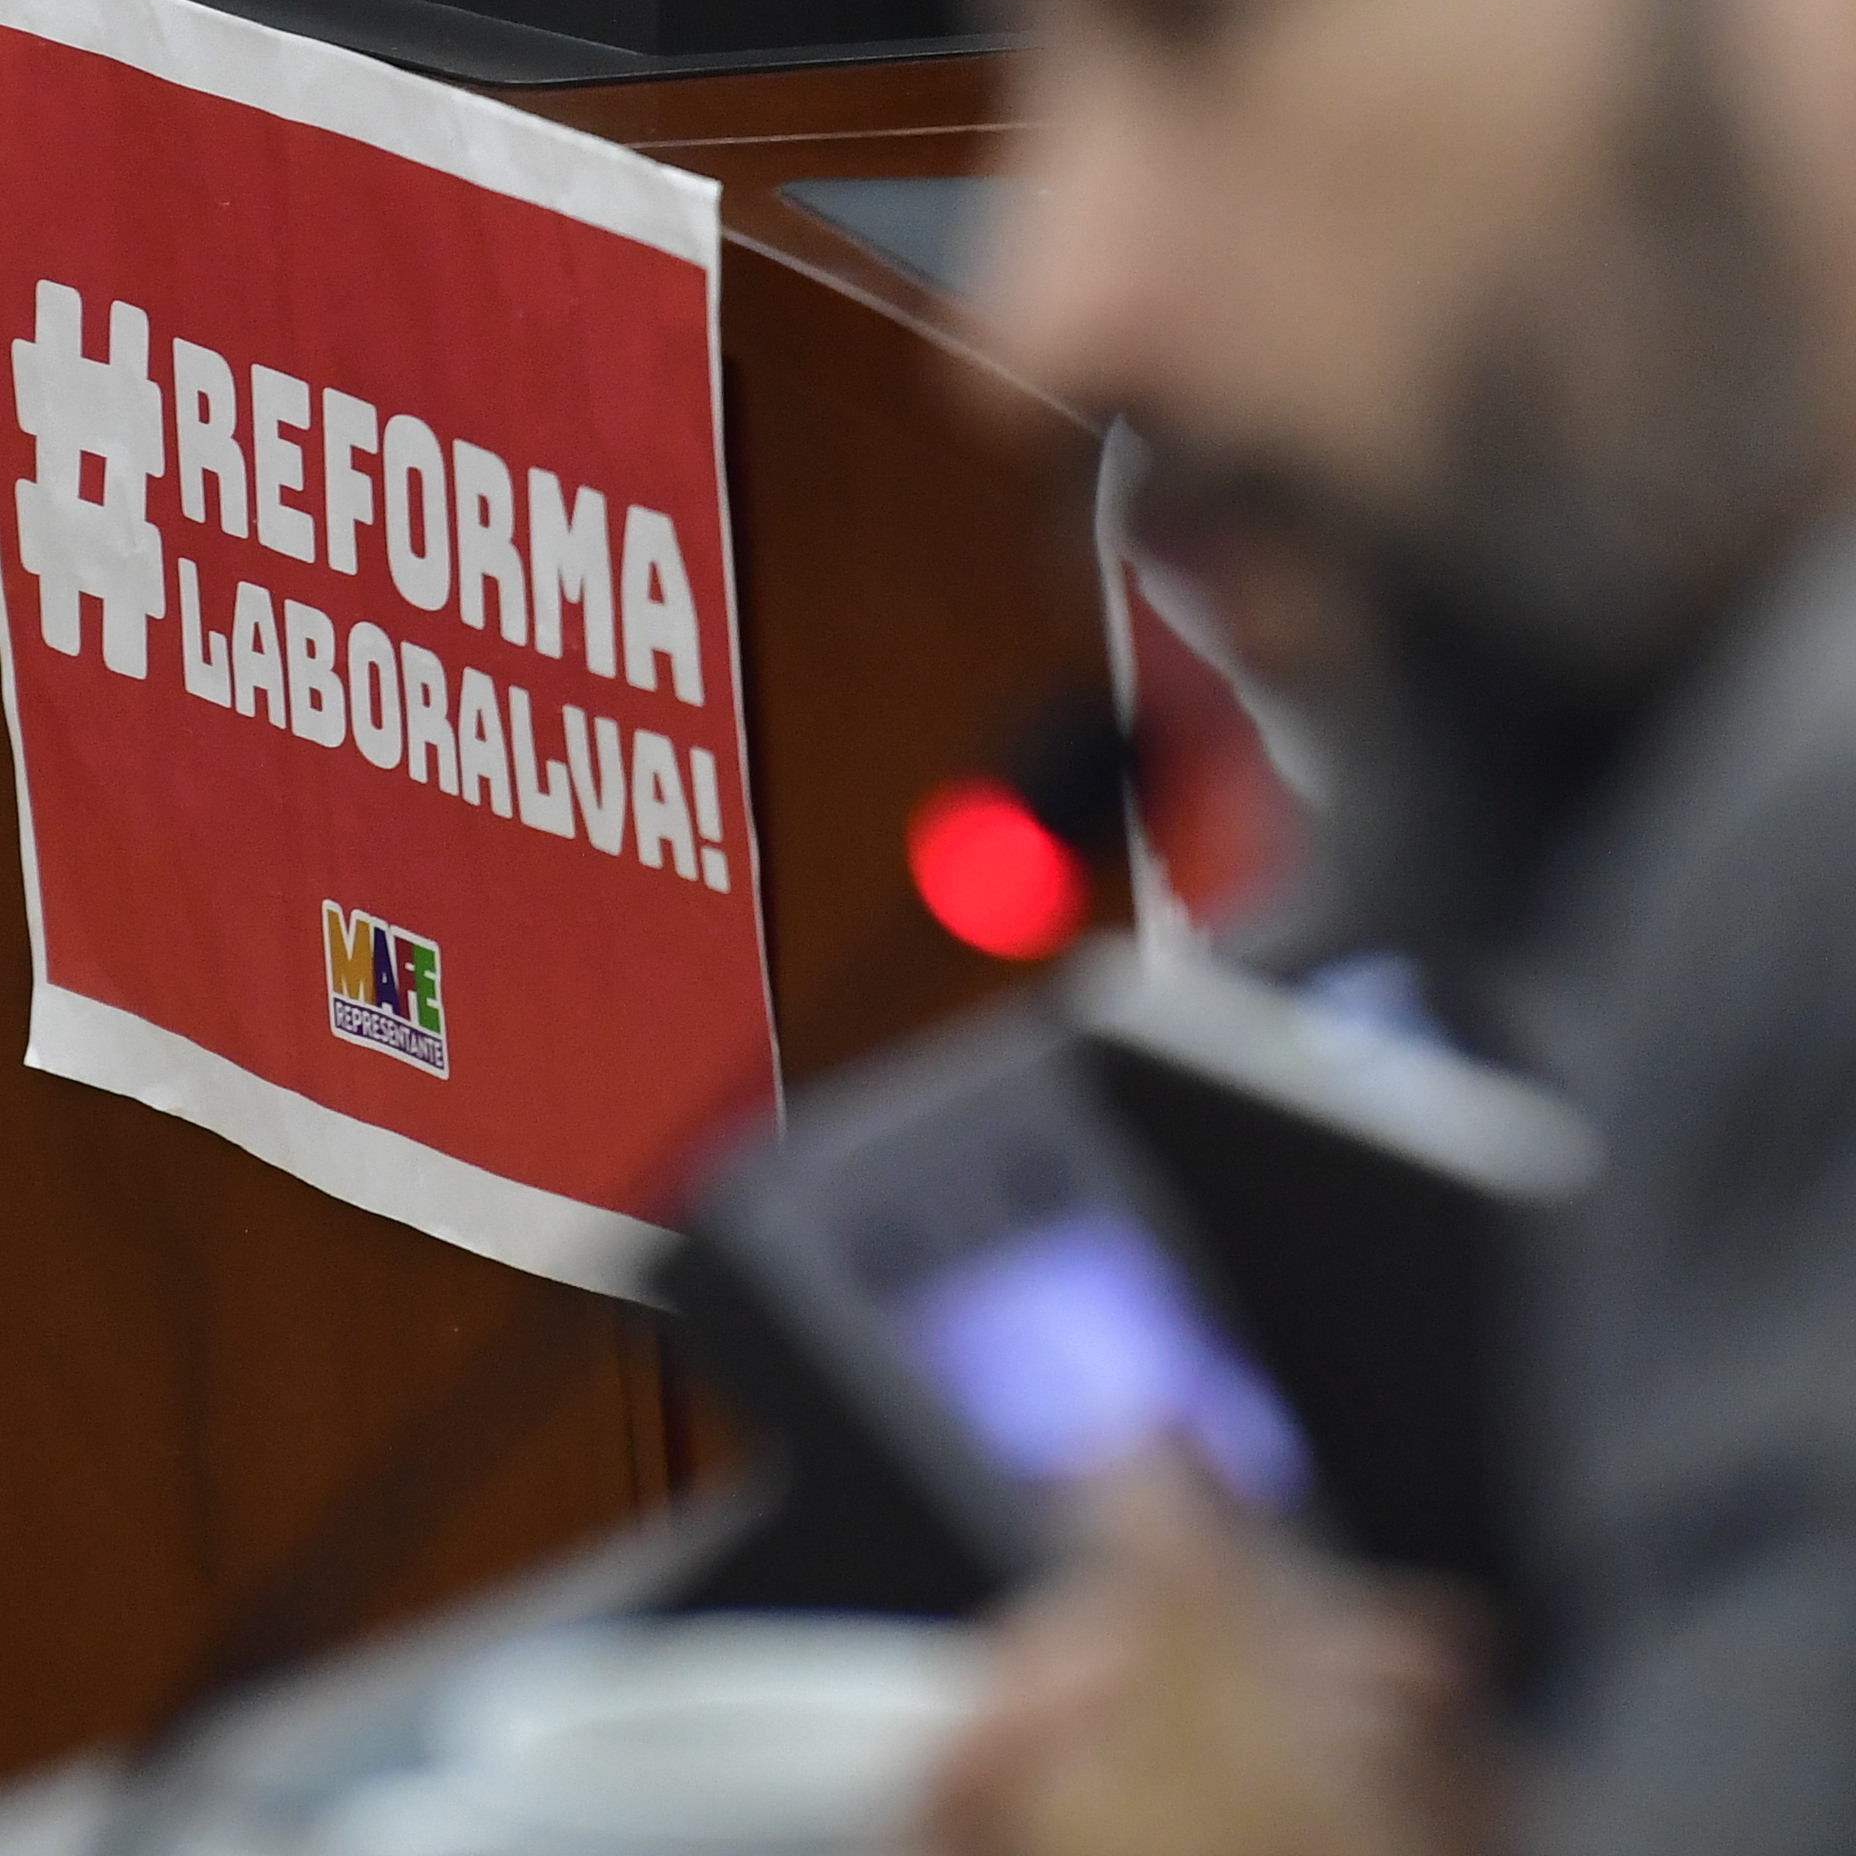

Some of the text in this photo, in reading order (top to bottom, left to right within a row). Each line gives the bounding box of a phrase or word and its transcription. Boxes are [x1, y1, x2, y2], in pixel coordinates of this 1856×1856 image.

[11, 279, 705, 708] #REFORMA
[324, 904, 442, 1035] MAFE
[335, 1001, 445, 1069] REPRESENTANTE
